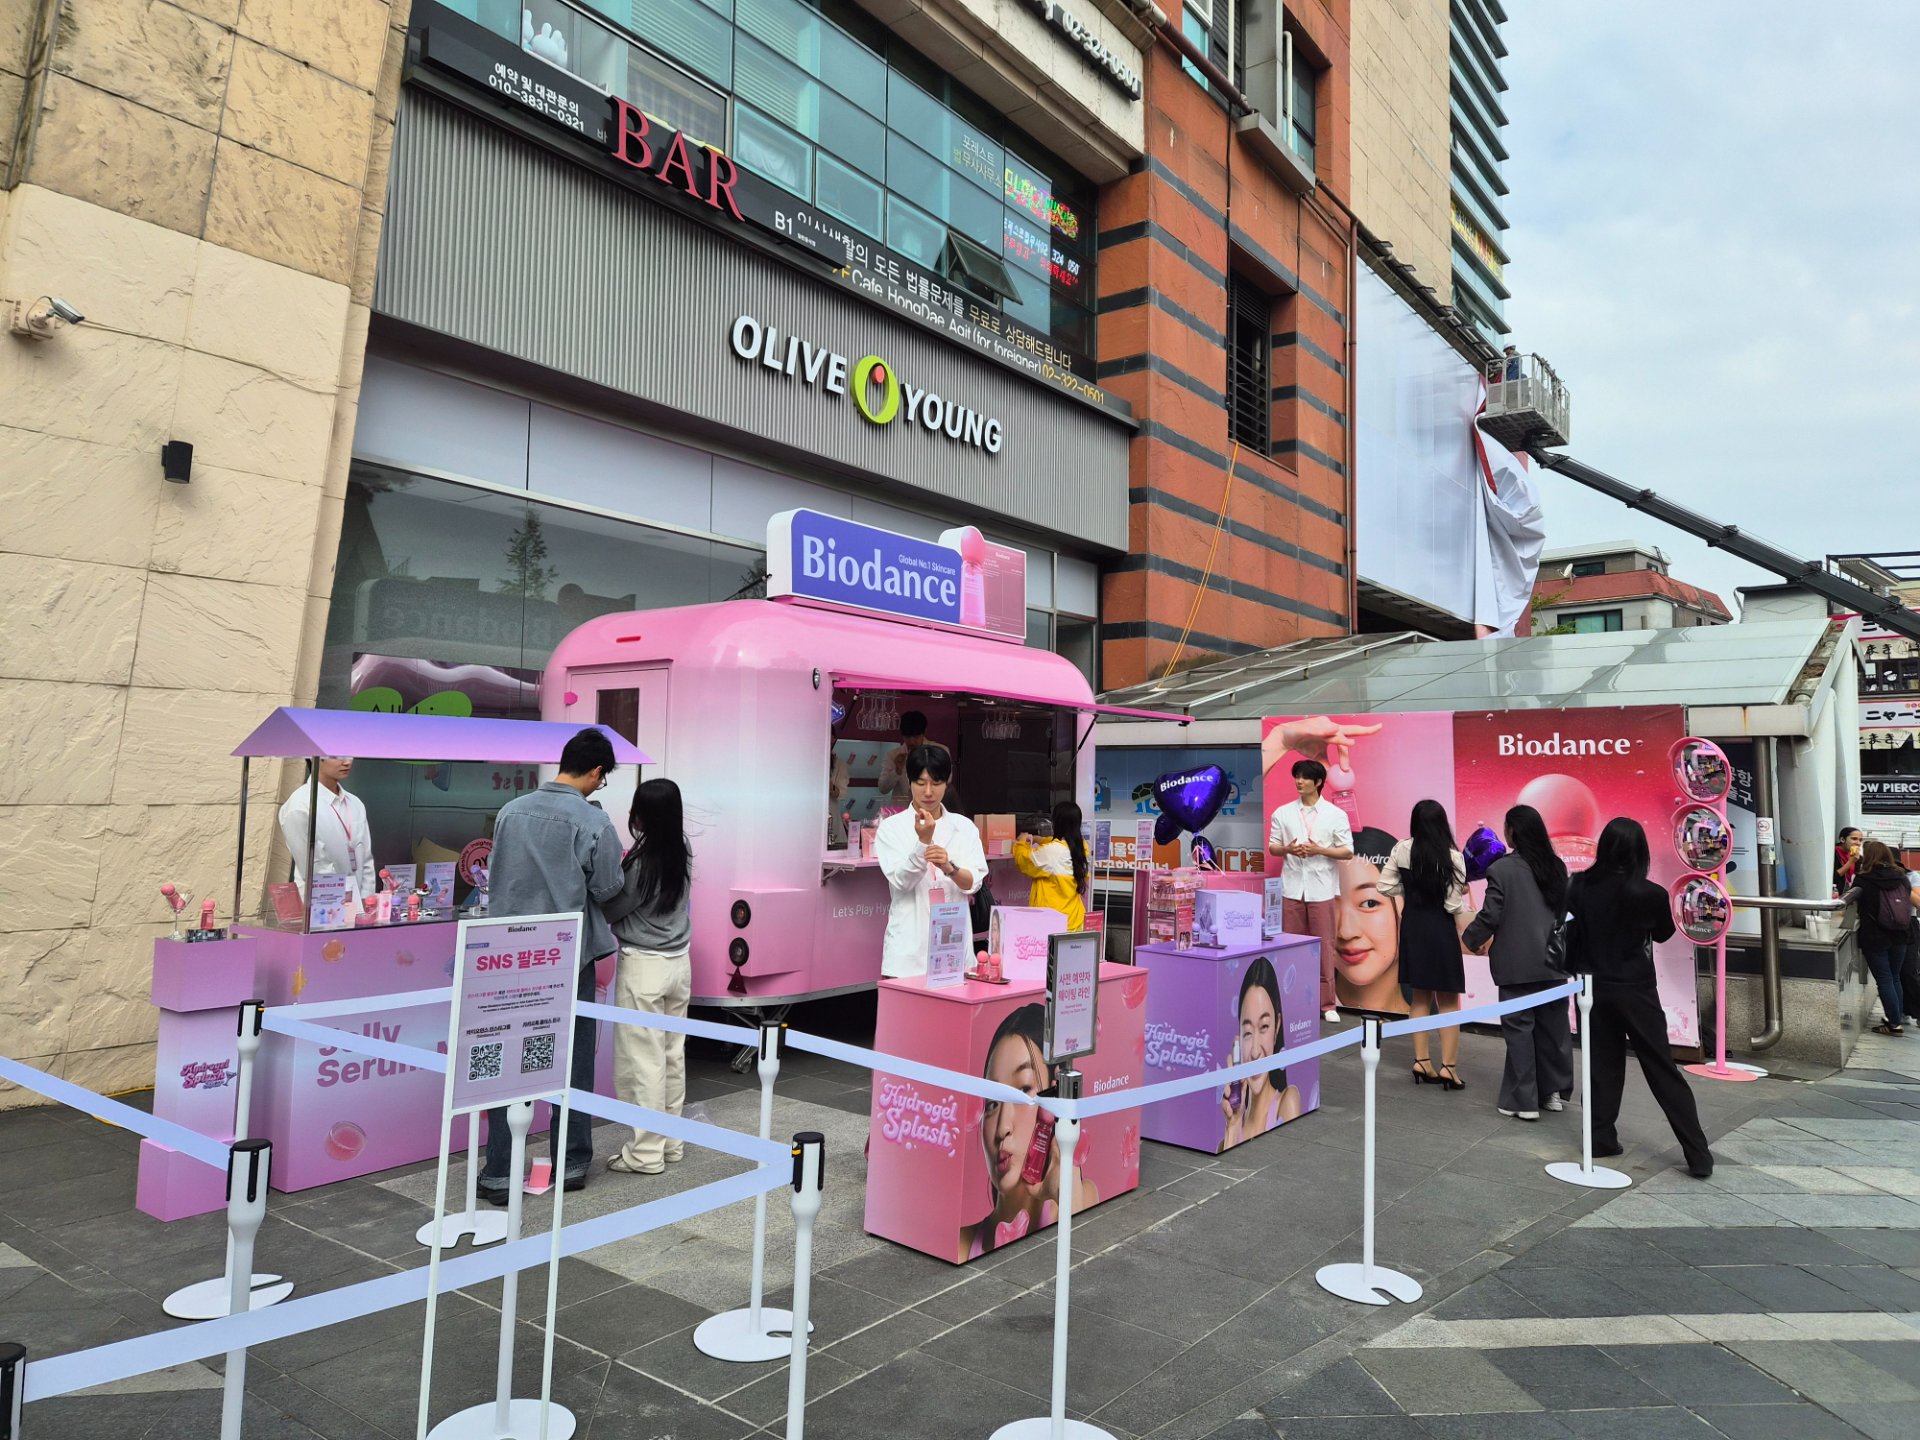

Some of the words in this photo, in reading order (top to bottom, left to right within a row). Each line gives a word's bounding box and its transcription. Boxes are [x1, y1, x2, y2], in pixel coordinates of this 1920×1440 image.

[495, 62, 518, 85] 예약
[521, 75, 532, 92] 및
[535, 83, 579, 116] 대관문의
[488, 74, 584, 132] 010-3831-0321
[609, 95, 745, 222] BAR
[962, 134, 995, 167] 포레스트
[774, 210, 793, 235] B1
[874, 254, 900, 284] 모든
[905, 269, 965, 318] 법률문제를
[969, 303, 1001, 335] 무료로
[1005, 323, 1072, 372] 상담해드립니다
[852, 268, 883, 297] Cafe
[973, 327, 991, 350] (for
[1042, 363, 1104, 405] 02-322-0501
[732, 314, 847, 395] OLIVE
[904, 383, 1002, 453] YOUNG
[803, 535, 957, 607] Biodance
[898, 553, 918, 567] Global
[918, 558, 931, 570] No.1
[931, 561, 956, 576] Skincare
[1498, 732, 1631, 756] Biodance
[1160, 774, 1214, 792] Biodance
[832, 905, 854, 918] Let's
[855, 903, 874, 917] Play
[507, 925, 538, 933] Biodance
[476, 953, 514, 972] SNS
[516, 947, 562, 970] 팔로우
[1058, 973, 1071, 986] 사전
[1072, 970, 1091, 984] 예약자
[1077, 986, 1091, 999] 라인
[1144, 1023, 1210, 1051] Hydrogel
[1145, 1041, 1206, 1068] Splash
[1093, 1074, 1130, 1093] Biodance
[879, 1082, 958, 1124] Hydrogel
[882, 1107, 952, 1147] Splash
